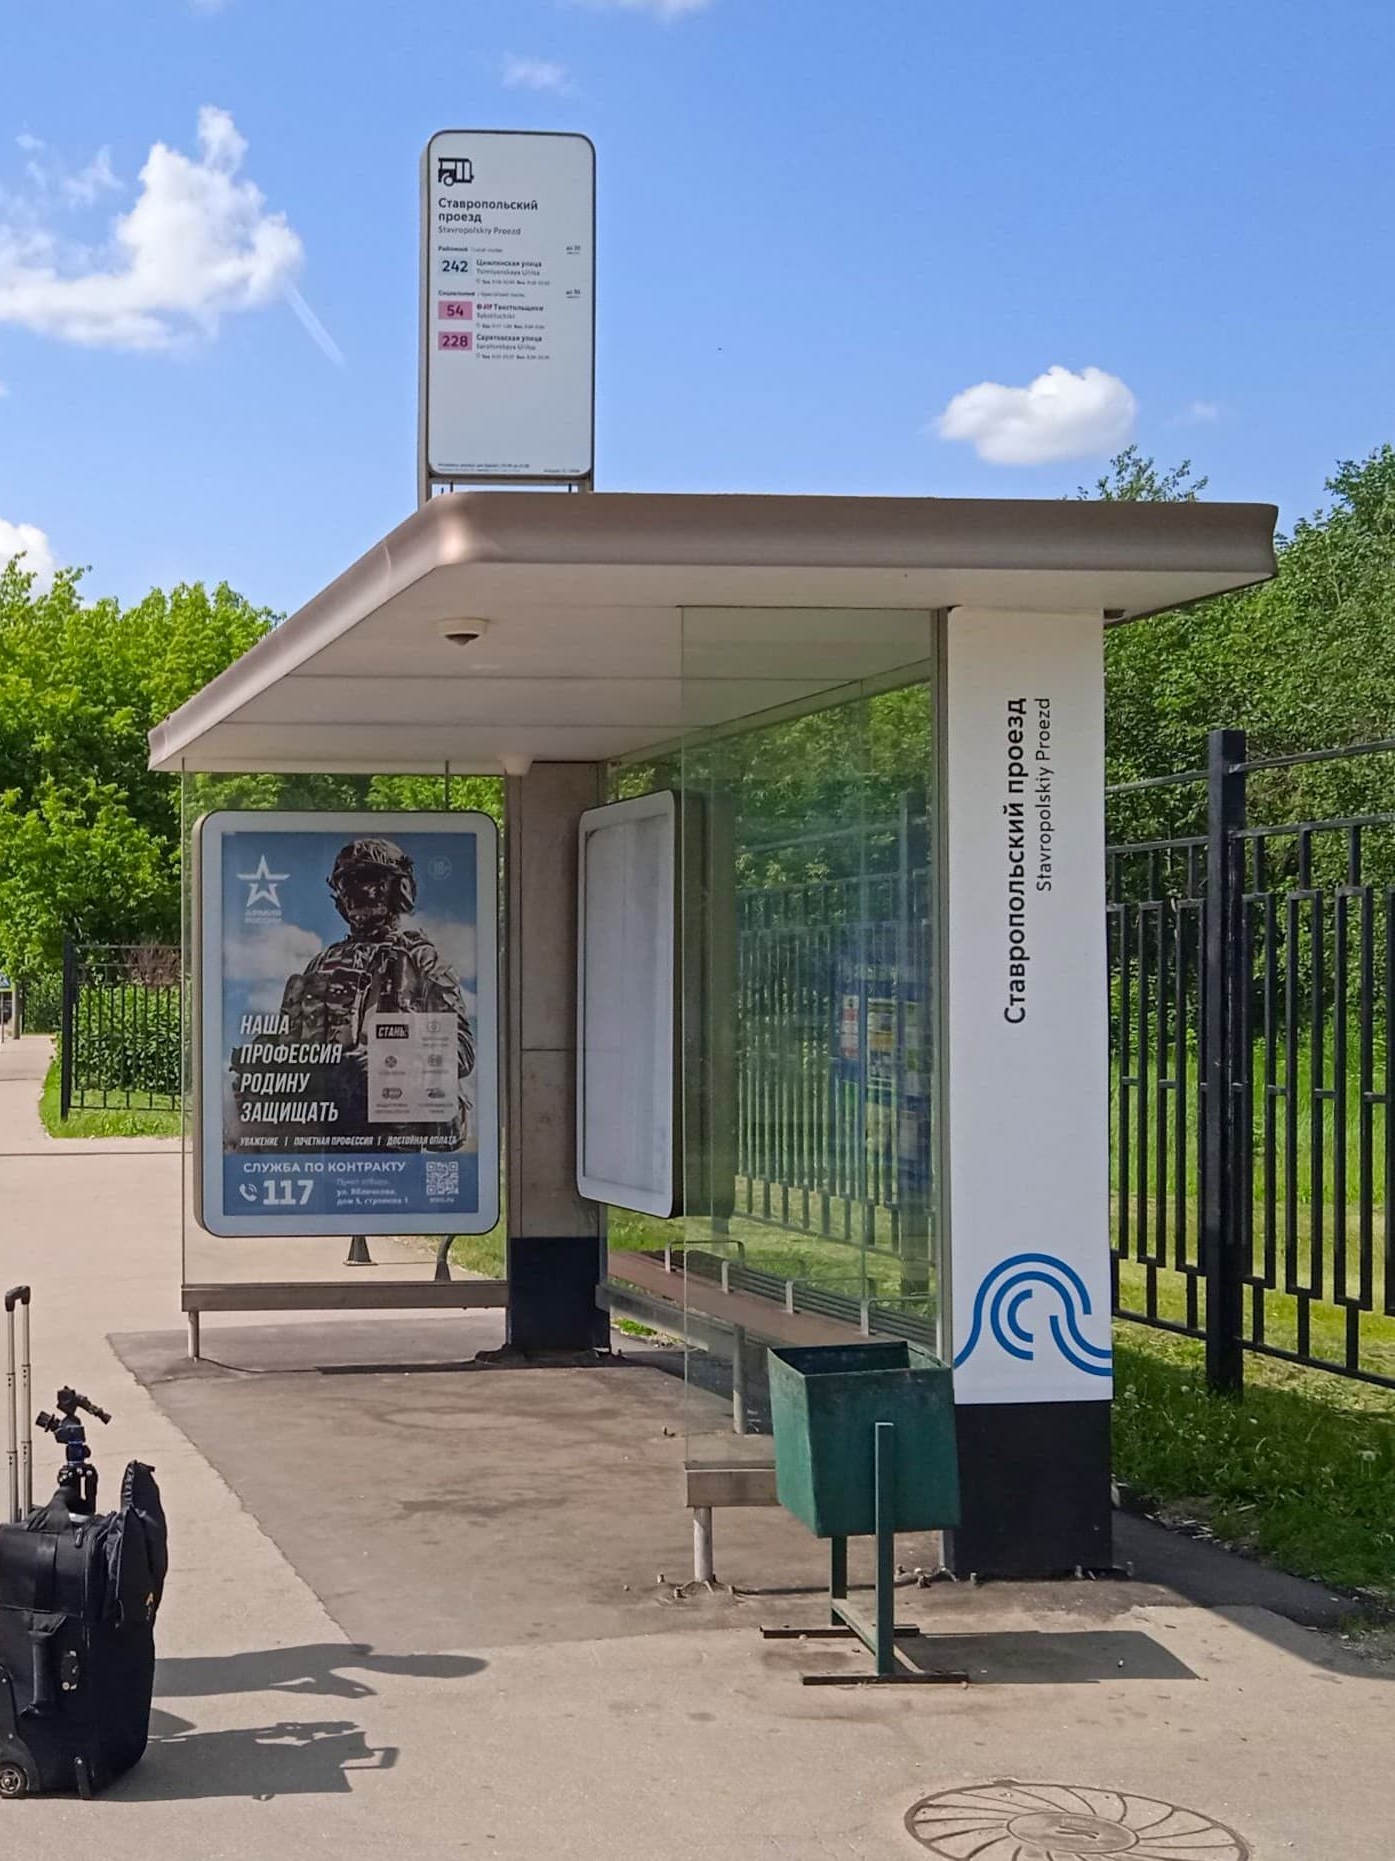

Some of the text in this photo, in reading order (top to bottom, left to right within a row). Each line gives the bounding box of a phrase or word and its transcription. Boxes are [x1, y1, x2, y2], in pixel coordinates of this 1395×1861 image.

[438, 197, 538, 211] Ставропольский
[438, 212, 482, 224] проезд
[493, 226, 521, 235] Proezd
[442, 259, 468, 273] 242
[446, 304, 464, 317] 54
[442, 335, 468, 348] 228
[1033, 697, 1055, 892] Stavropolskiy Proezd
[1003, 698, 1030, 1024] Ставропольский проезд
[240, 1015, 290, 1035] НАША
[240, 1043, 343, 1064] ПРОФЕССИЯ
[240, 1072, 311, 1095] РОДИНУ
[240, 1101, 339, 1124] ЗАЩИЩАТЬ
[240, 1136, 279, 1146] УВАЖЕНИЕ
[331, 1136, 374, 1146] ПРОФЕССИЯ
[386, 1134, 428, 1147] ДОСТОЙНАЯ
[429, 1135, 456, 1146] ОПЛАТА
[243, 1161, 406, 1173] СЛУЖБА ПО КОНТРАКТУ
[262, 1179, 314, 1206] 117
